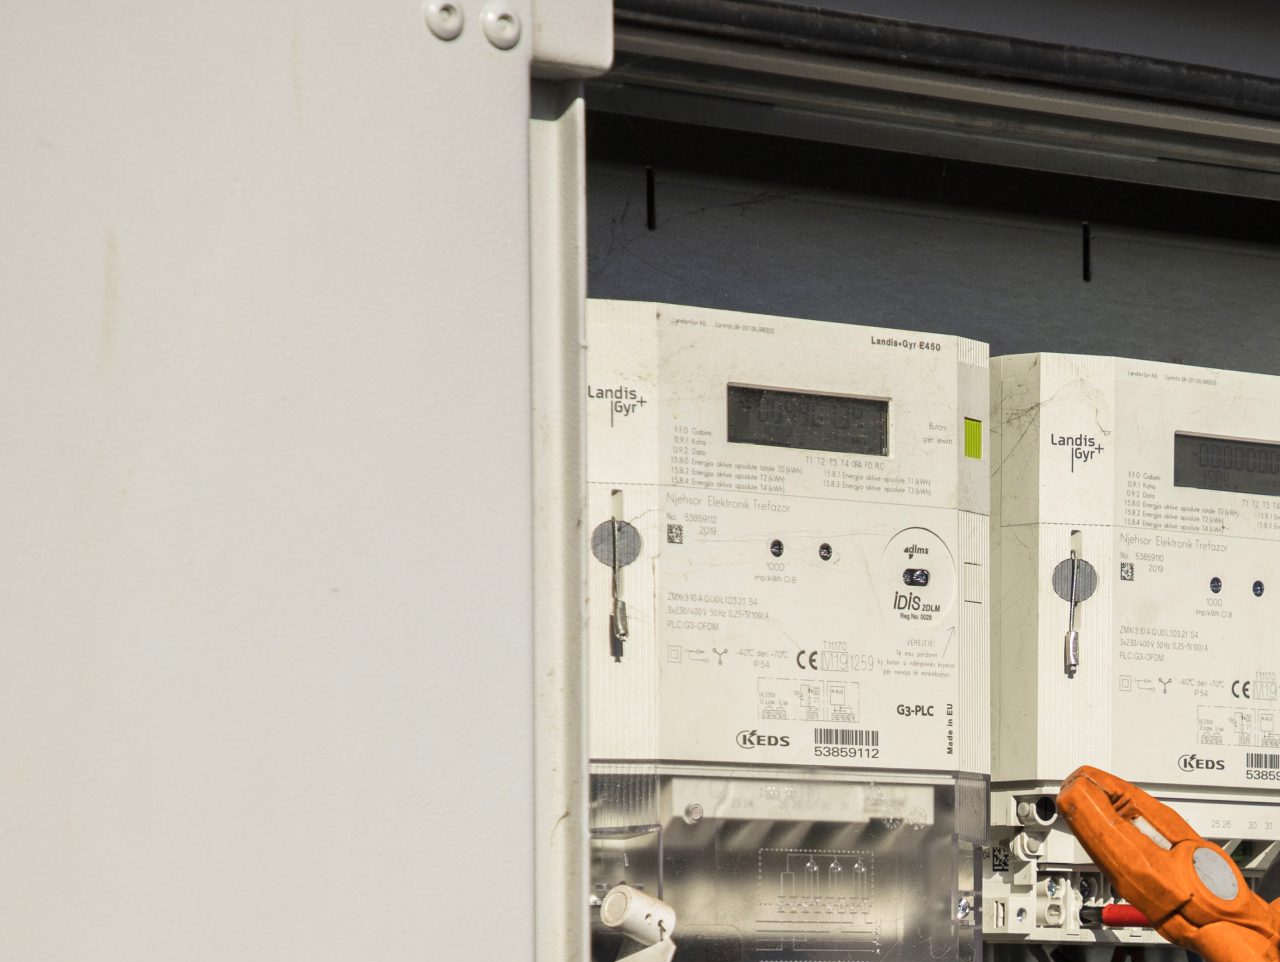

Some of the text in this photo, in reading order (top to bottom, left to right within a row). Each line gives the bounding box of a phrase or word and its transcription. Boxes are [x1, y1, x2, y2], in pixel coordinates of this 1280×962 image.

[920, 341, 941, 352] E450
[588, 385, 637, 400] Landis
[1050, 434, 1095, 447] Landis
[707, 494, 749, 509] Elektronik
[752, 498, 790, 513] Trefazor
[698, 525, 717, 536] 2019
[1155, 534, 1192, 549] Elektronik
[1195, 538, 1228, 552] Trefazor
[766, 561, 785, 572] 1000
[1147, 563, 1164, 573] 2019
[921, 603, 940, 612] 2DLM
[1206, 597, 1222, 607] 1000
[899, 612, 910, 621] Reg
[822, 652, 848, 671] M19
[850, 653, 874, 672] 1259
[1254, 682, 1276, 700] M19
[896, 703, 934, 718] G3-PLC
[946, 703, 954, 755] Made in EU
[741, 728, 790, 748] KEDS
[814, 745, 879, 759] 53859112
[1182, 753, 1225, 771] KEDS
